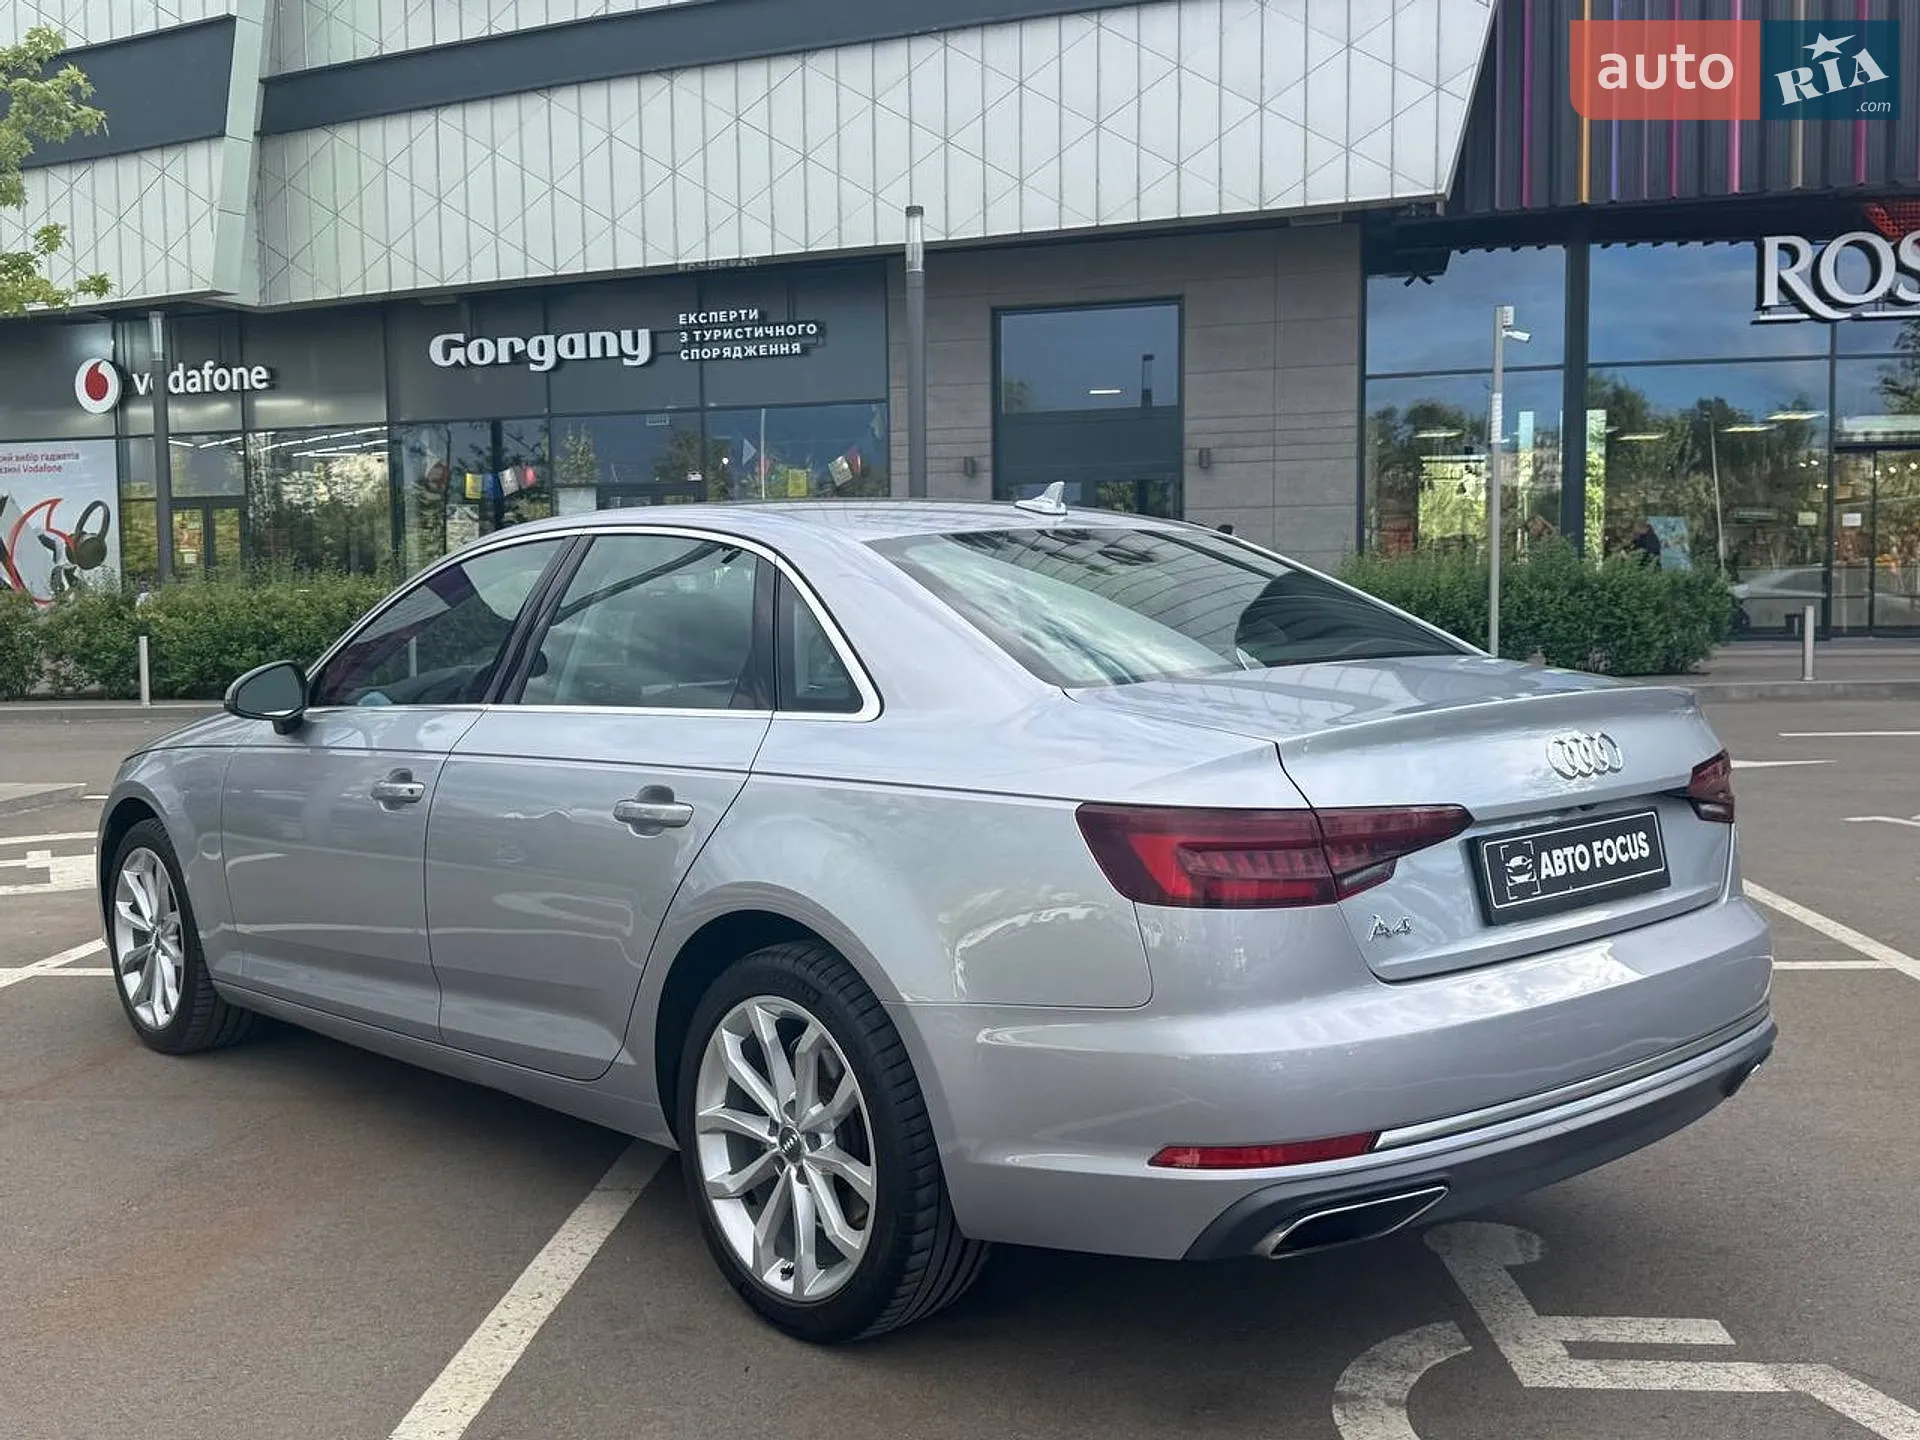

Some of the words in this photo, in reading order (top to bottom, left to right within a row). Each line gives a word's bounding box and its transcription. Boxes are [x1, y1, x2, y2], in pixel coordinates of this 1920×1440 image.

[678, 308, 759, 325] ЕКСПЕРТИ
[679, 331, 689, 343] З
[692, 323, 818, 342] ТУРИСТИЧНОГО
[428, 328, 650, 372] Gorgany
[679, 342, 802, 361] СПОРЯДЖЕННЯ
[131, 360, 271, 396] vdafone
[1592, 830, 1650, 868] FOCUS
[1368, 913, 1412, 942] A4
